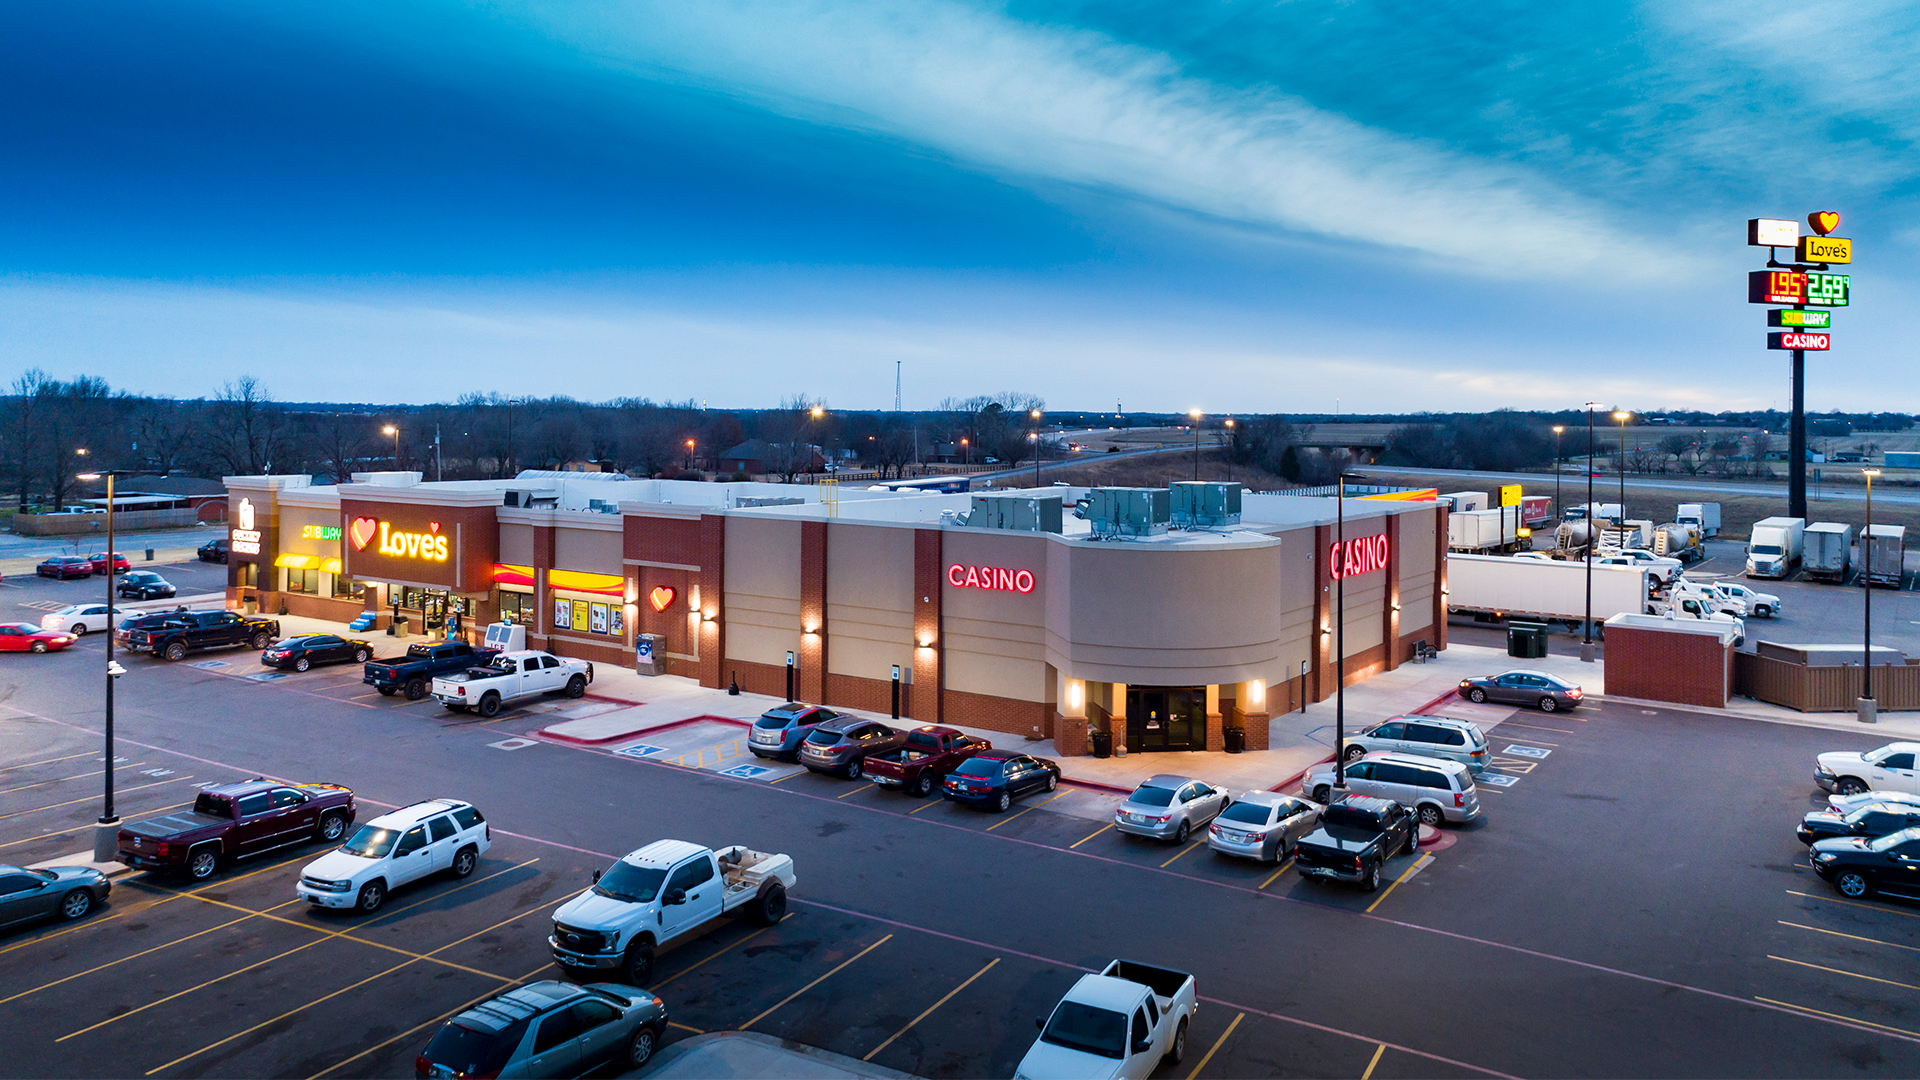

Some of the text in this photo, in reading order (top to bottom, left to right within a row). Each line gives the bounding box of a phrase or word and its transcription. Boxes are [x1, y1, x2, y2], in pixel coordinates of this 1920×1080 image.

[1771, 271, 1801, 296] 1.95
[1808, 274, 1844, 298] 2.69
[1782, 311, 1829, 325] SUBWAY
[1783, 334, 1828, 348] CASINO
[302, 525, 342, 541] SUBWAY
[1330, 533, 1388, 580] CASINO
[947, 563, 1035, 594] CASINO
